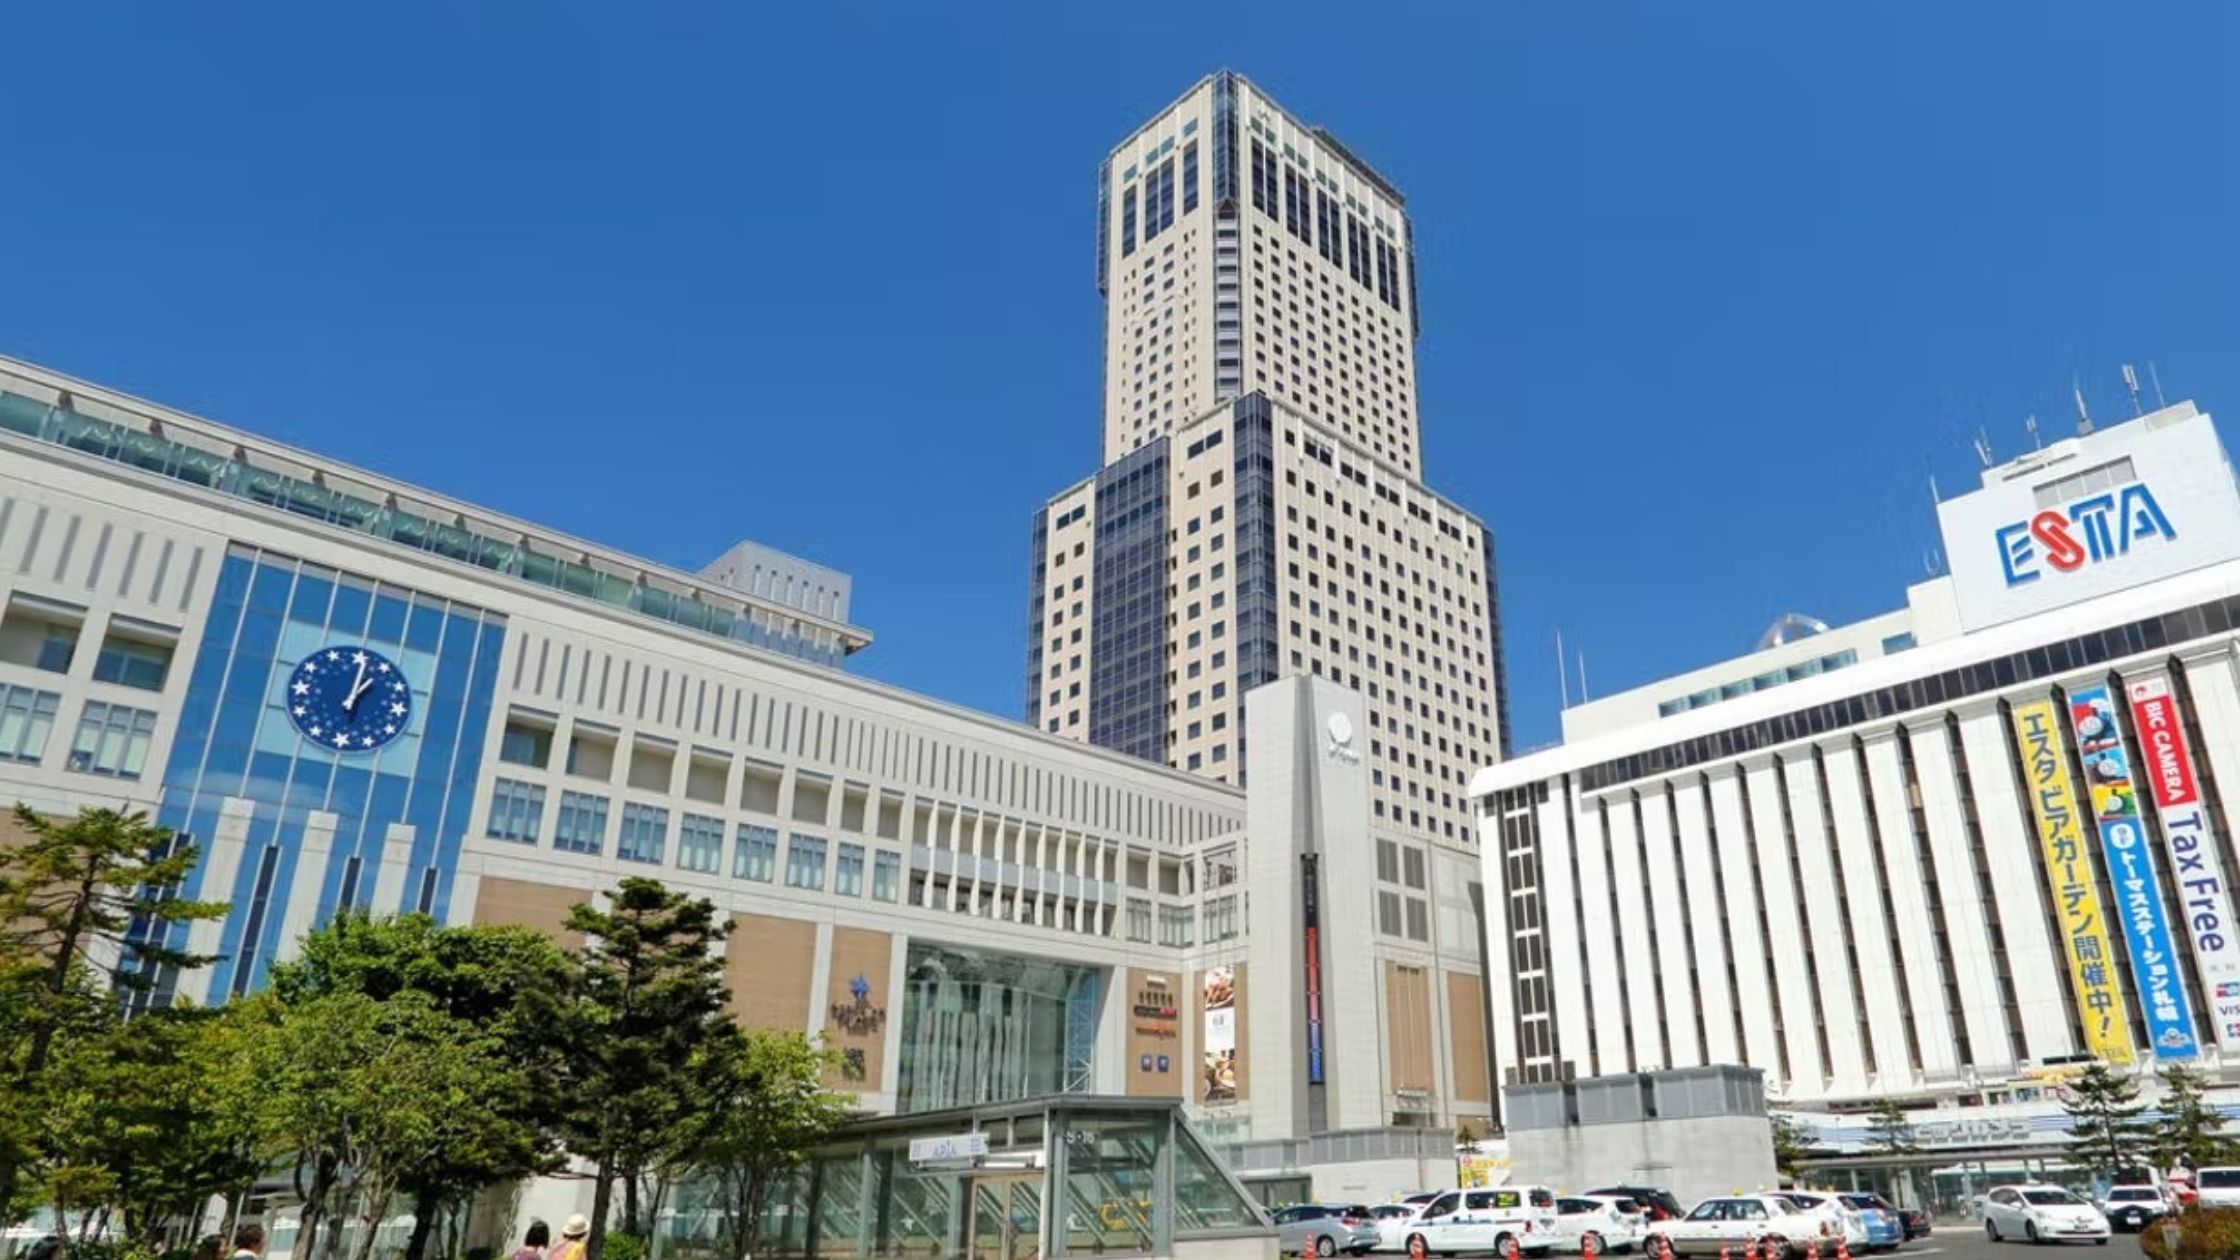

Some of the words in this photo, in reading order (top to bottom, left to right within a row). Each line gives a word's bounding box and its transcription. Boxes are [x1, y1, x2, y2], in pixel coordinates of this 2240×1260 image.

[1995, 482, 2177, 588] ESTA
[2144, 701, 2166, 730] BIC
[2153, 730, 2186, 801] CAMERA
[2168, 811, 2204, 873] Tax
[2183, 878, 2224, 951] Free
[2218, 1005, 2240, 1017] VIS
